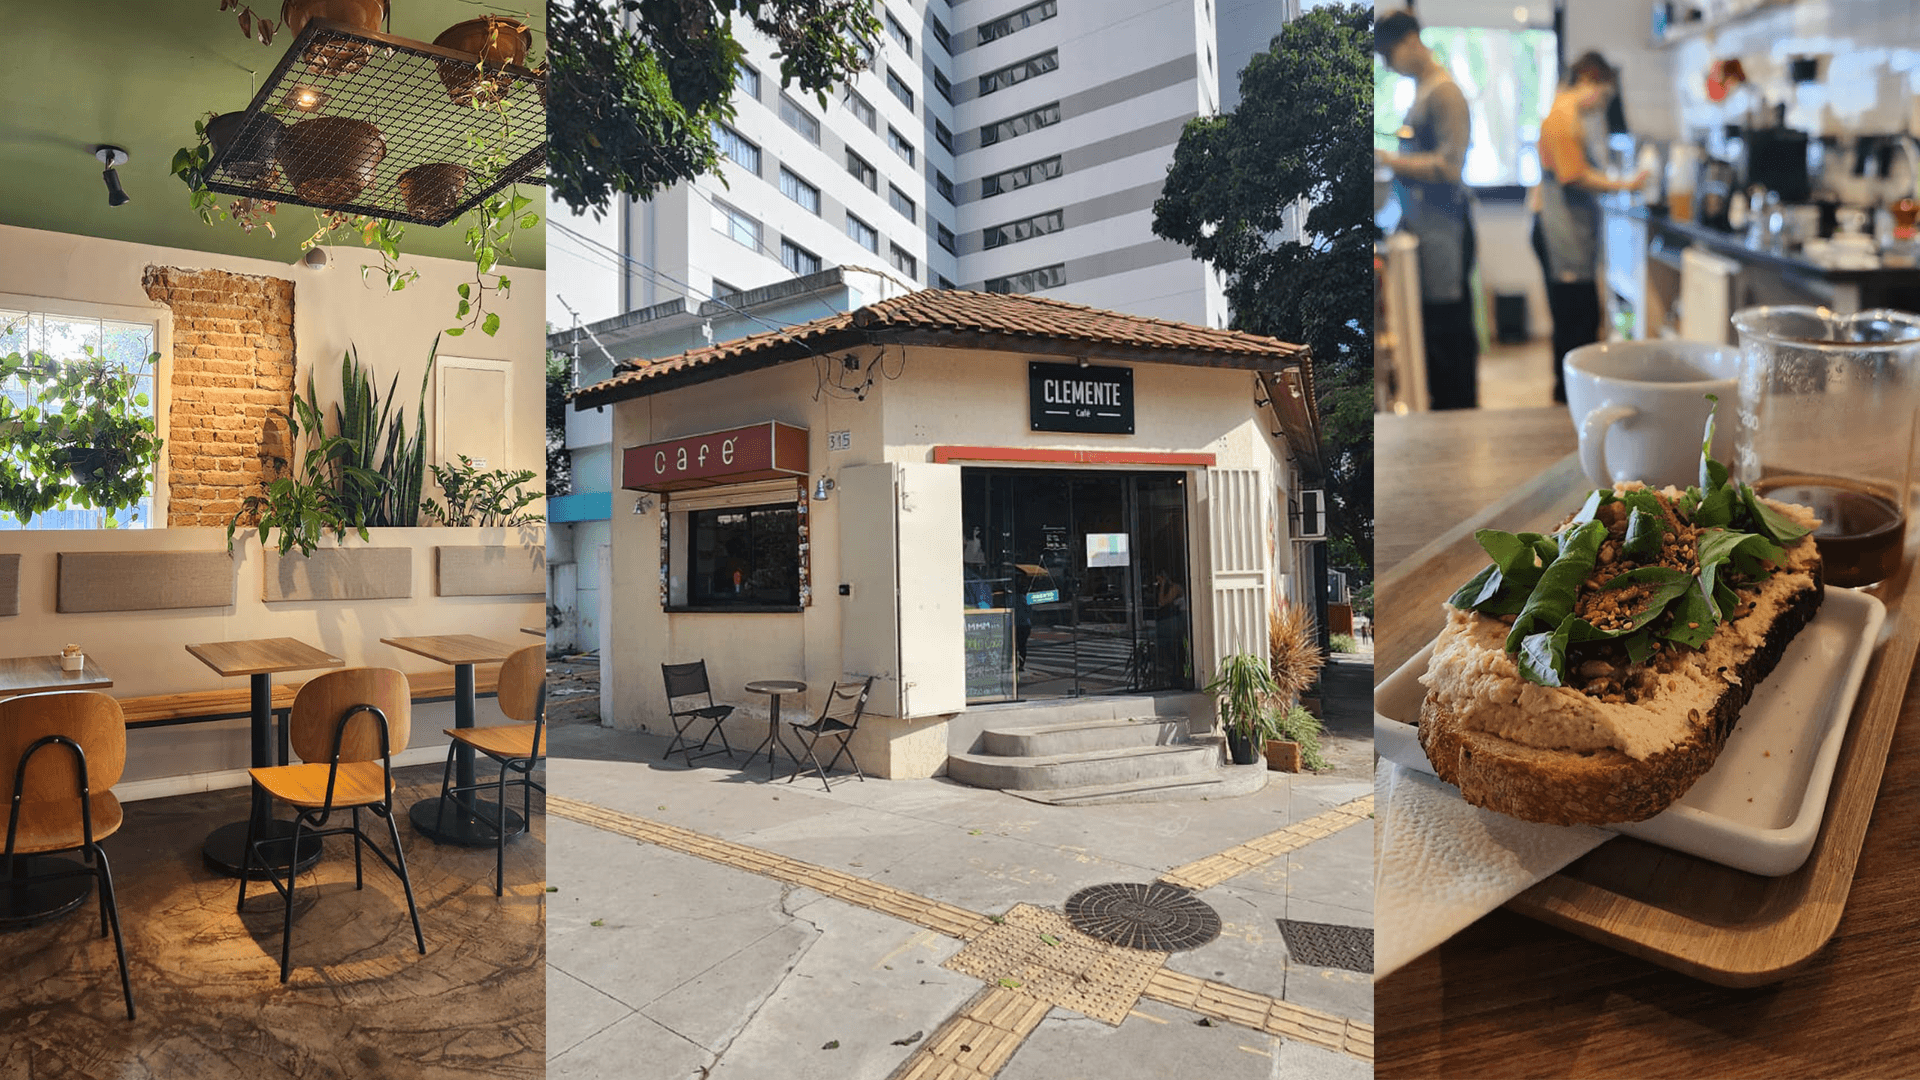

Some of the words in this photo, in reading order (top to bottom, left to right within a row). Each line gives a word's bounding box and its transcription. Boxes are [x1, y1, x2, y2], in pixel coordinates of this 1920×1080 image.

[1044, 379, 1121, 406] CLEMENTE
[1075, 408, 1091, 418] Café
[829, 433, 850, 449] 315
[654, 436, 738, 475] café
